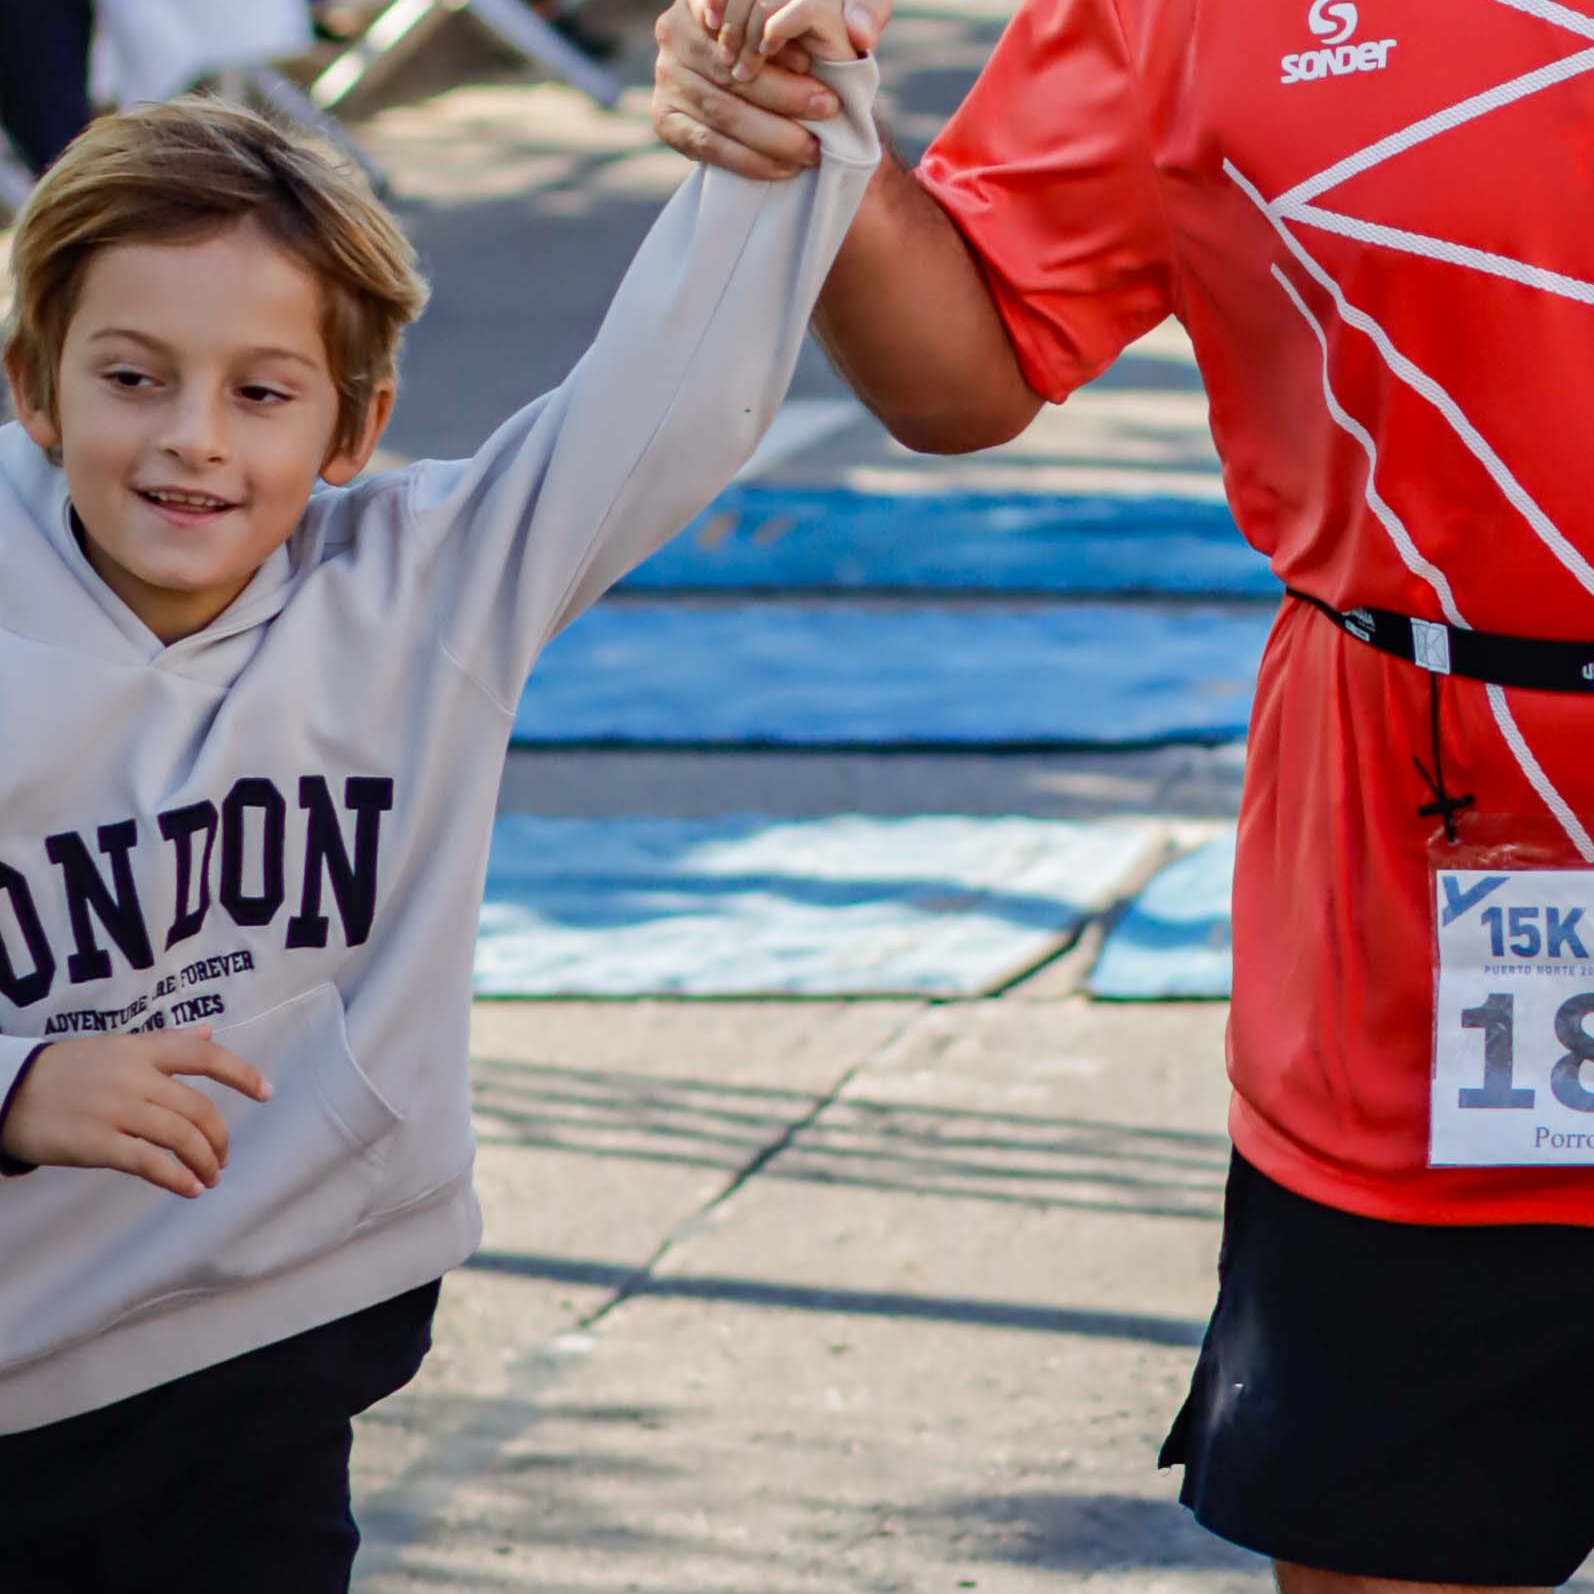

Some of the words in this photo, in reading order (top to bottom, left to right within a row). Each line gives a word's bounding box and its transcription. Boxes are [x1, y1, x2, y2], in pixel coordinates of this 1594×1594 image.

[0, 775, 394, 1008] ONDON
[1480, 907, 1590, 960] 15K
[1484, 964, 1532, 976] PUERTO
[1536, 965, 1576, 976] NORTE
[44, 996, 148, 1035] ADVENTURE
[152, 976, 176, 1001] RE
[170, 993, 225, 1026] TIMES
